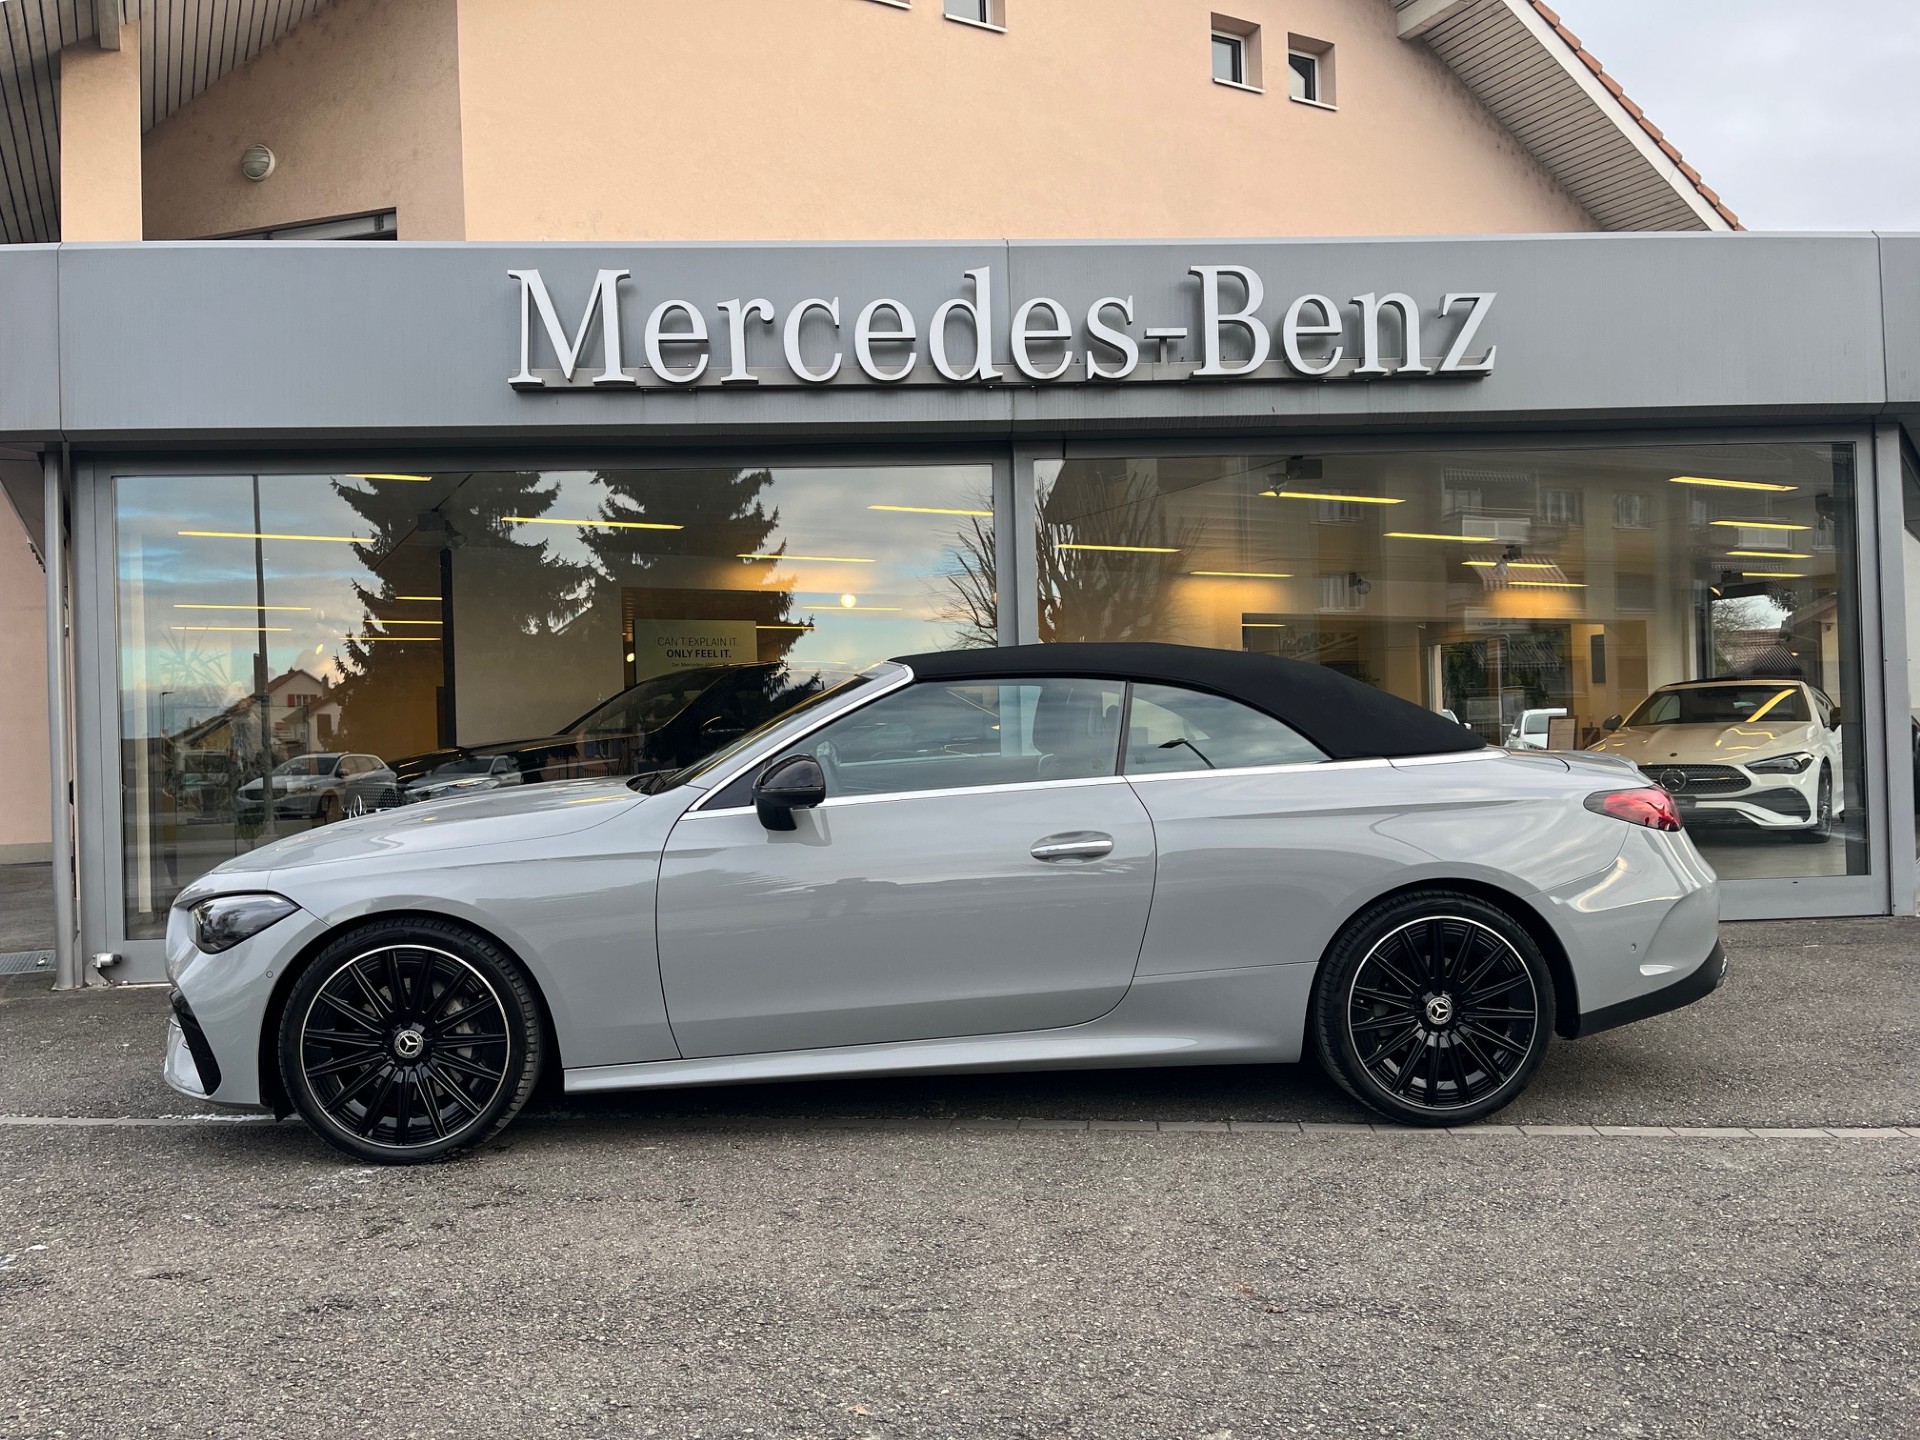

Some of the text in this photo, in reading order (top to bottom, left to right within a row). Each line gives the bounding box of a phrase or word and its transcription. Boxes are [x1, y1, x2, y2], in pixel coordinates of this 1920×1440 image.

[508, 264, 1497, 387] Mercedes-Benz
[657, 636, 686, 647] CAN'T
[688, 636, 727, 647] EXPLAIN
[666, 649, 732, 658] ONLY FEEL IT.
